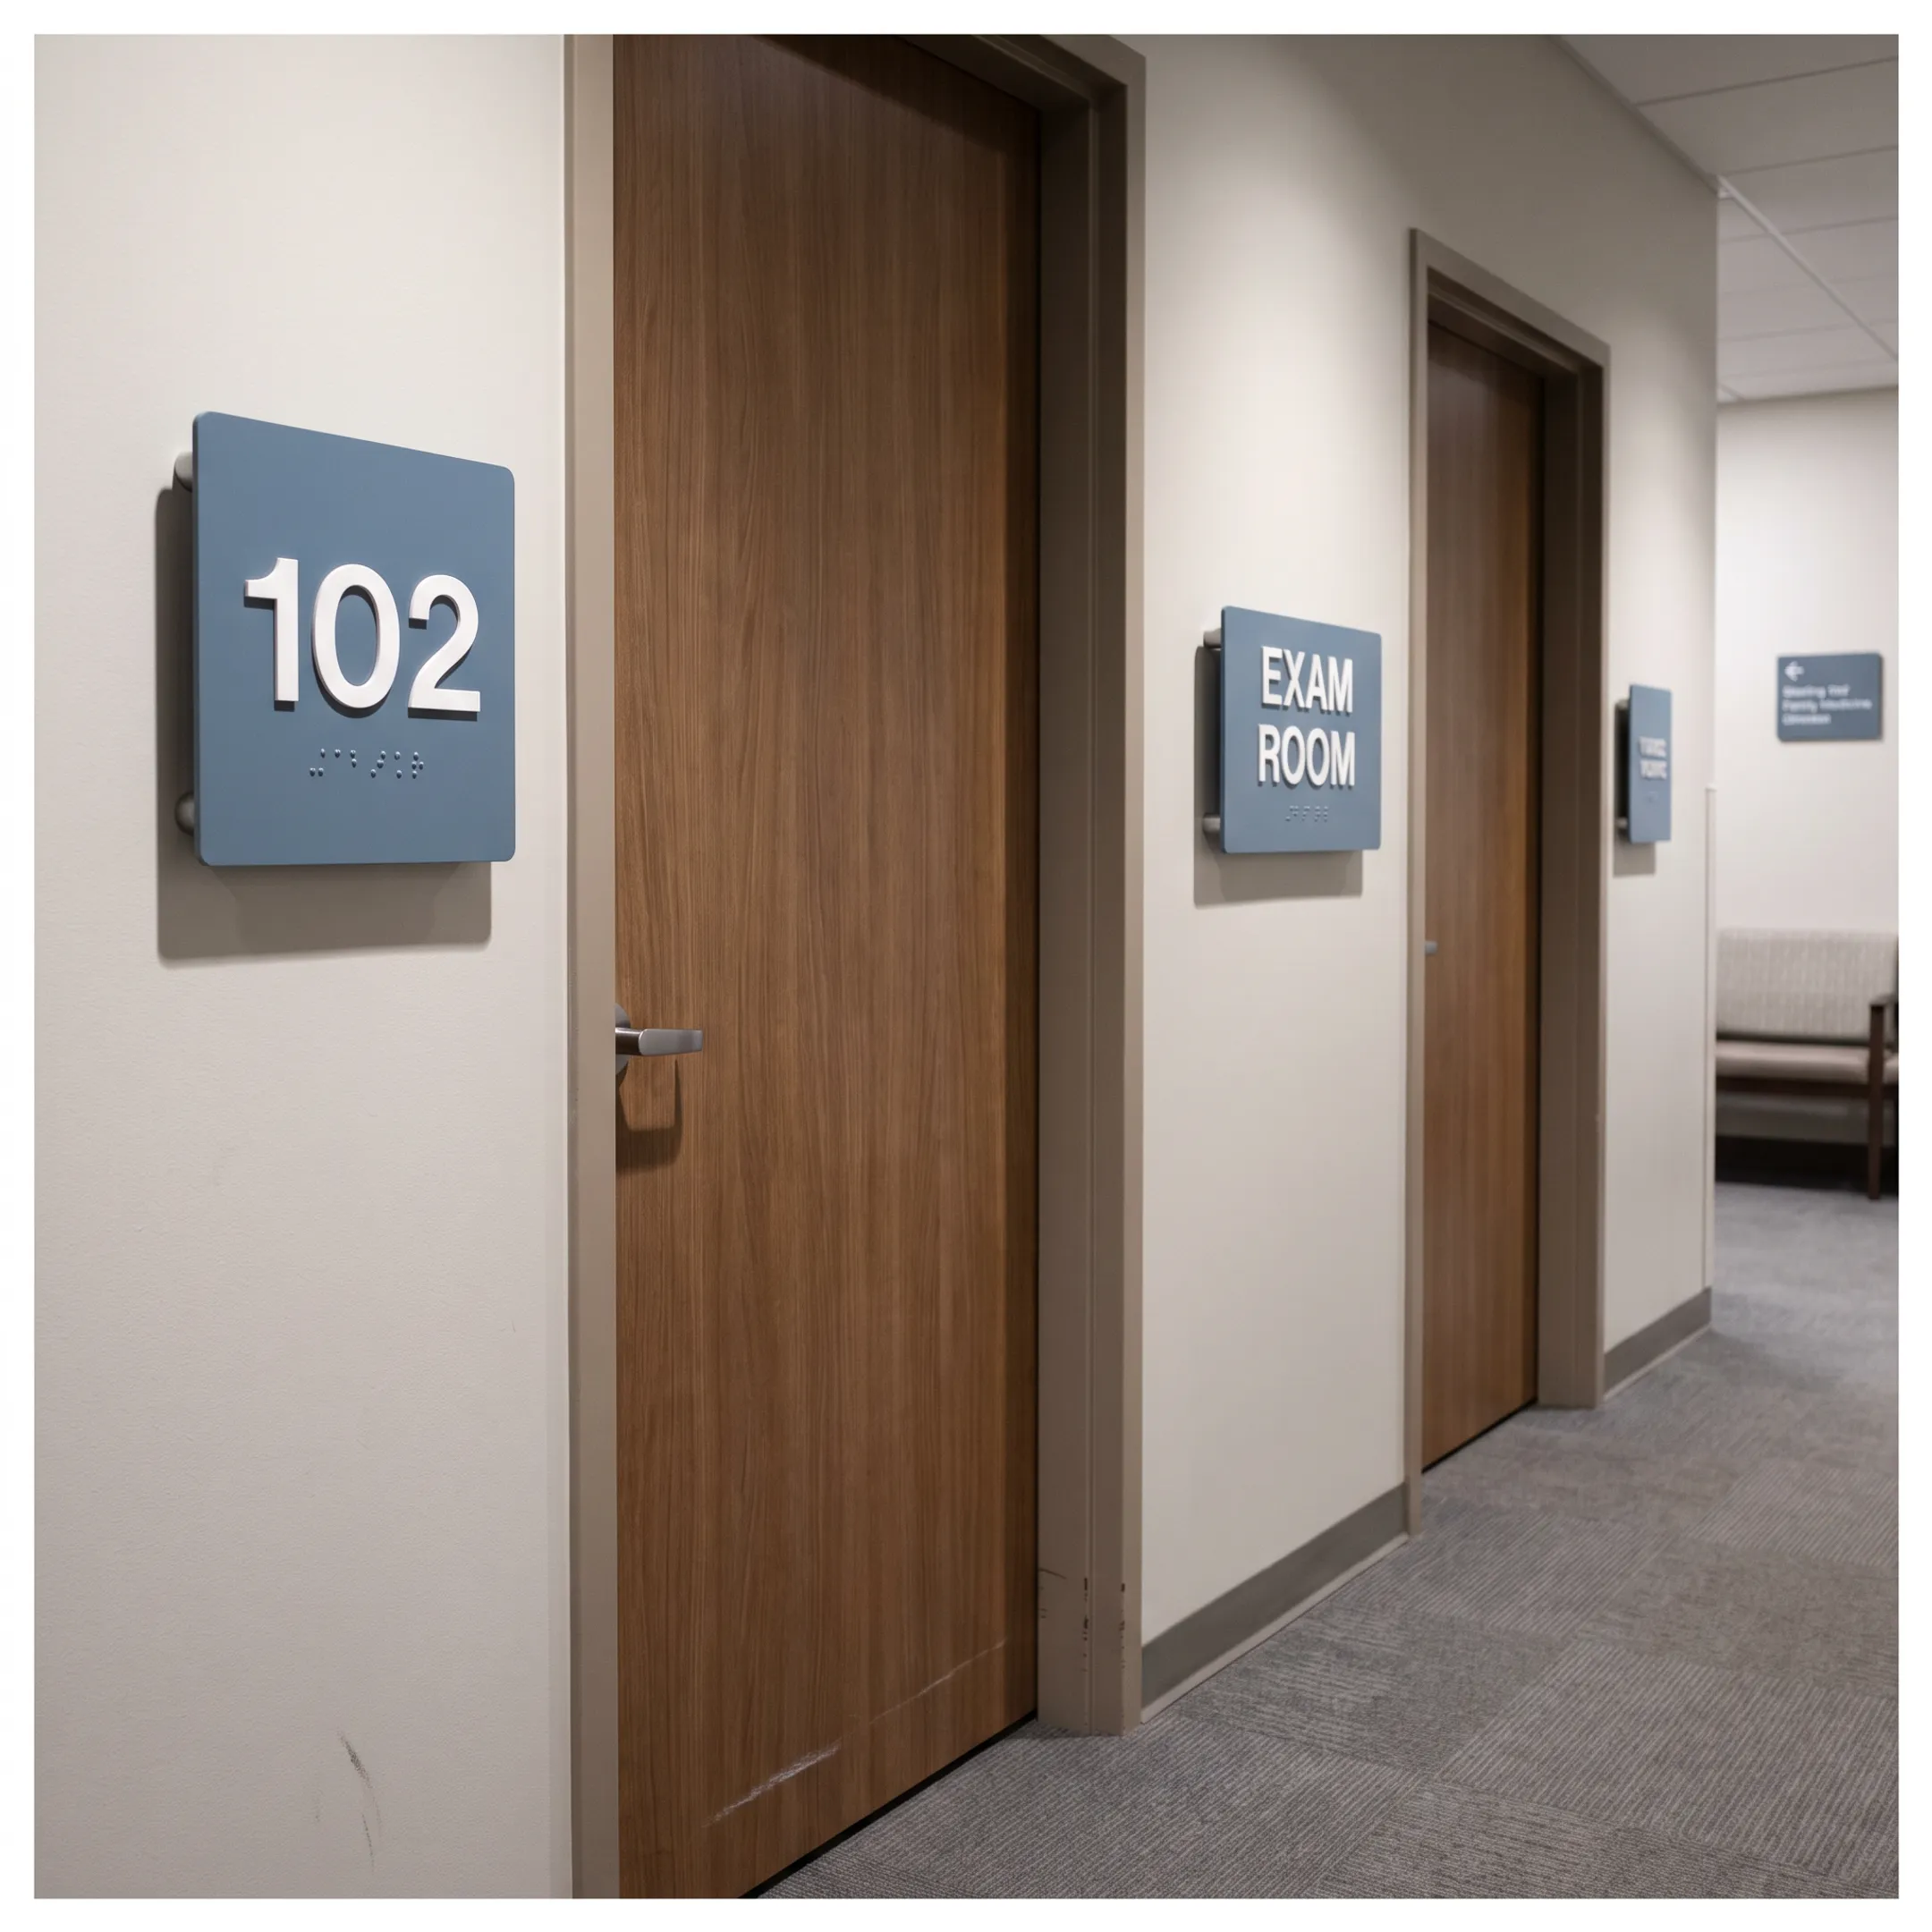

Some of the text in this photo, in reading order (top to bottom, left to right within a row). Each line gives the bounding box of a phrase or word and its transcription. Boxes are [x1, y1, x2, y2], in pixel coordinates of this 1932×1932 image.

[244, 556, 480, 713] 102
[1261, 645, 1353, 714] EXAM
[1258, 724, 1355, 787] ROOM
